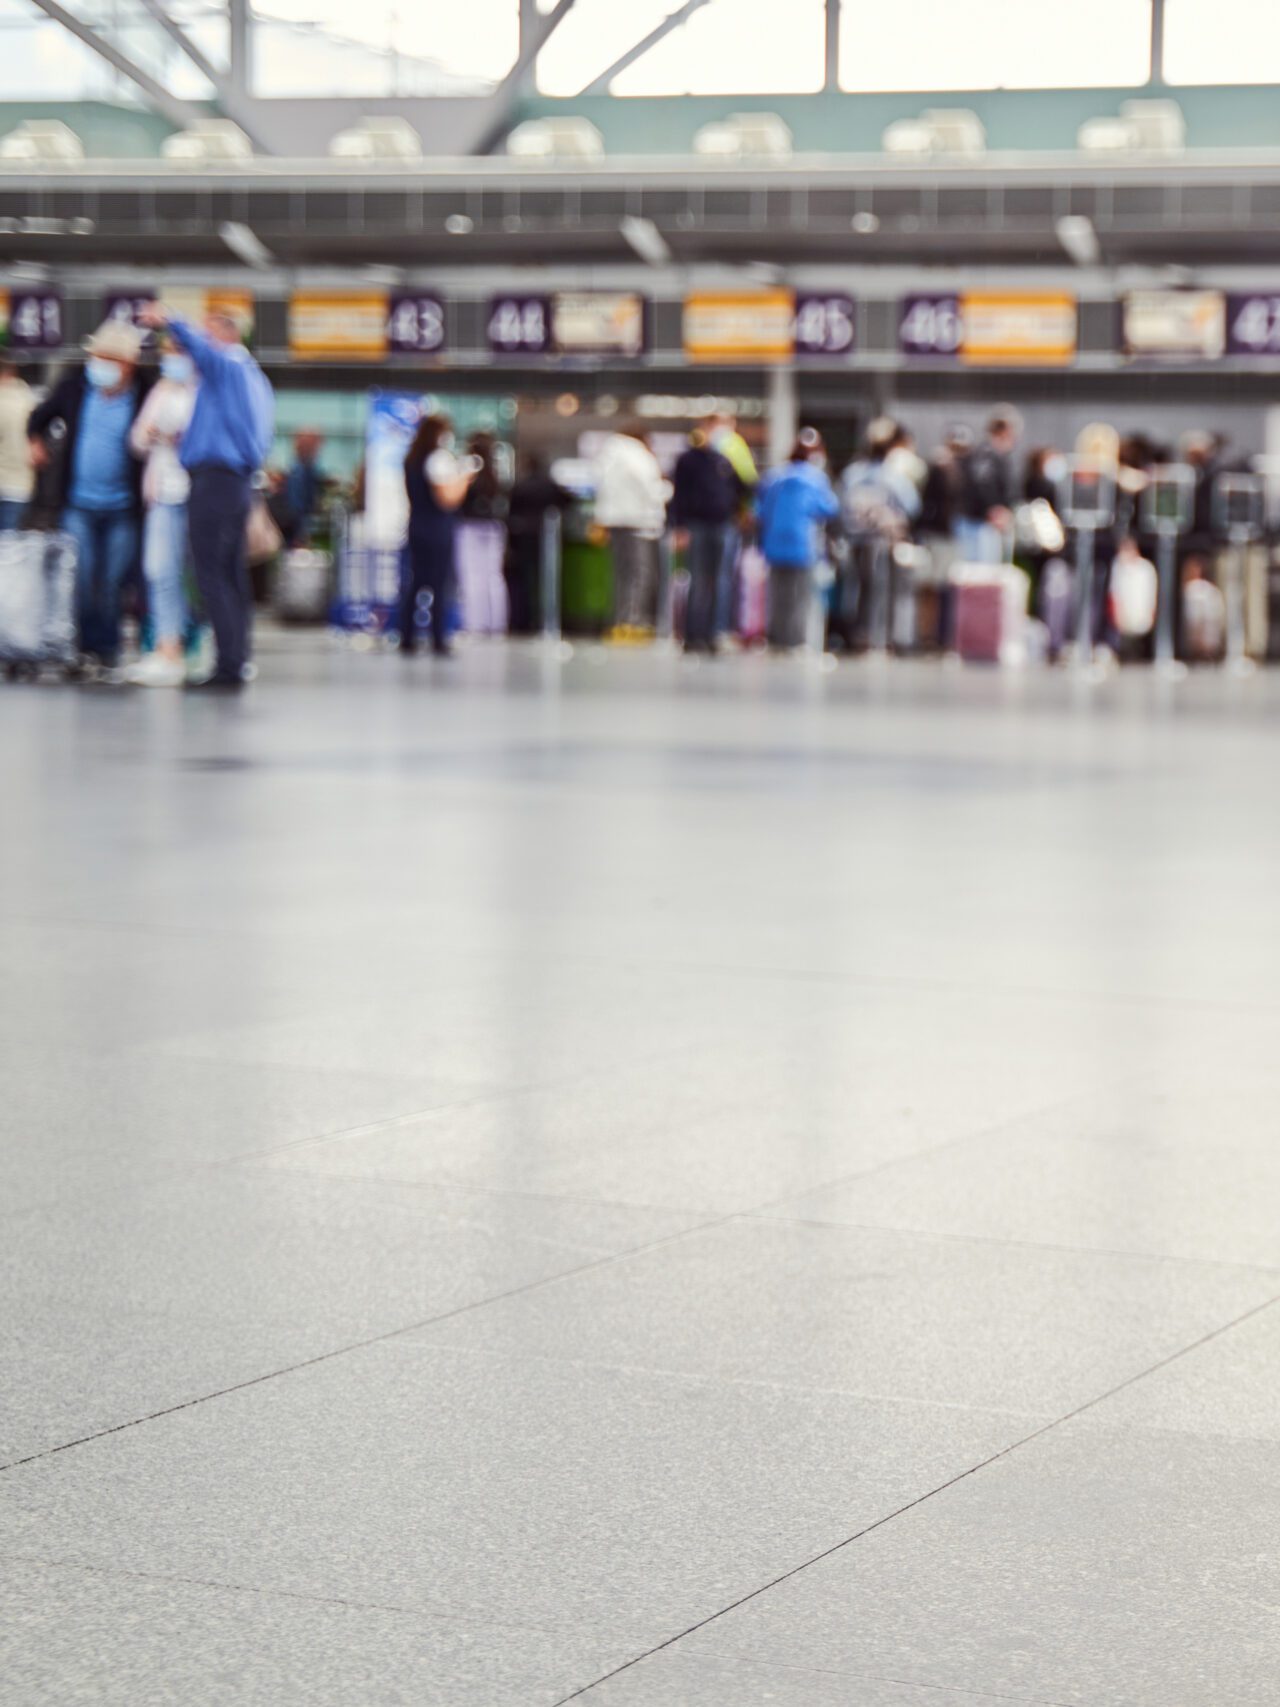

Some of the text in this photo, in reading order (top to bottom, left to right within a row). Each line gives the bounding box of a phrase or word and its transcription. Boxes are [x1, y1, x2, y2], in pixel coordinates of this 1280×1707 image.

[389, 298, 445, 350] 43
[489, 299, 546, 350] 44
[792, 298, 854, 350] 45
[901, 298, 962, 351] 46
